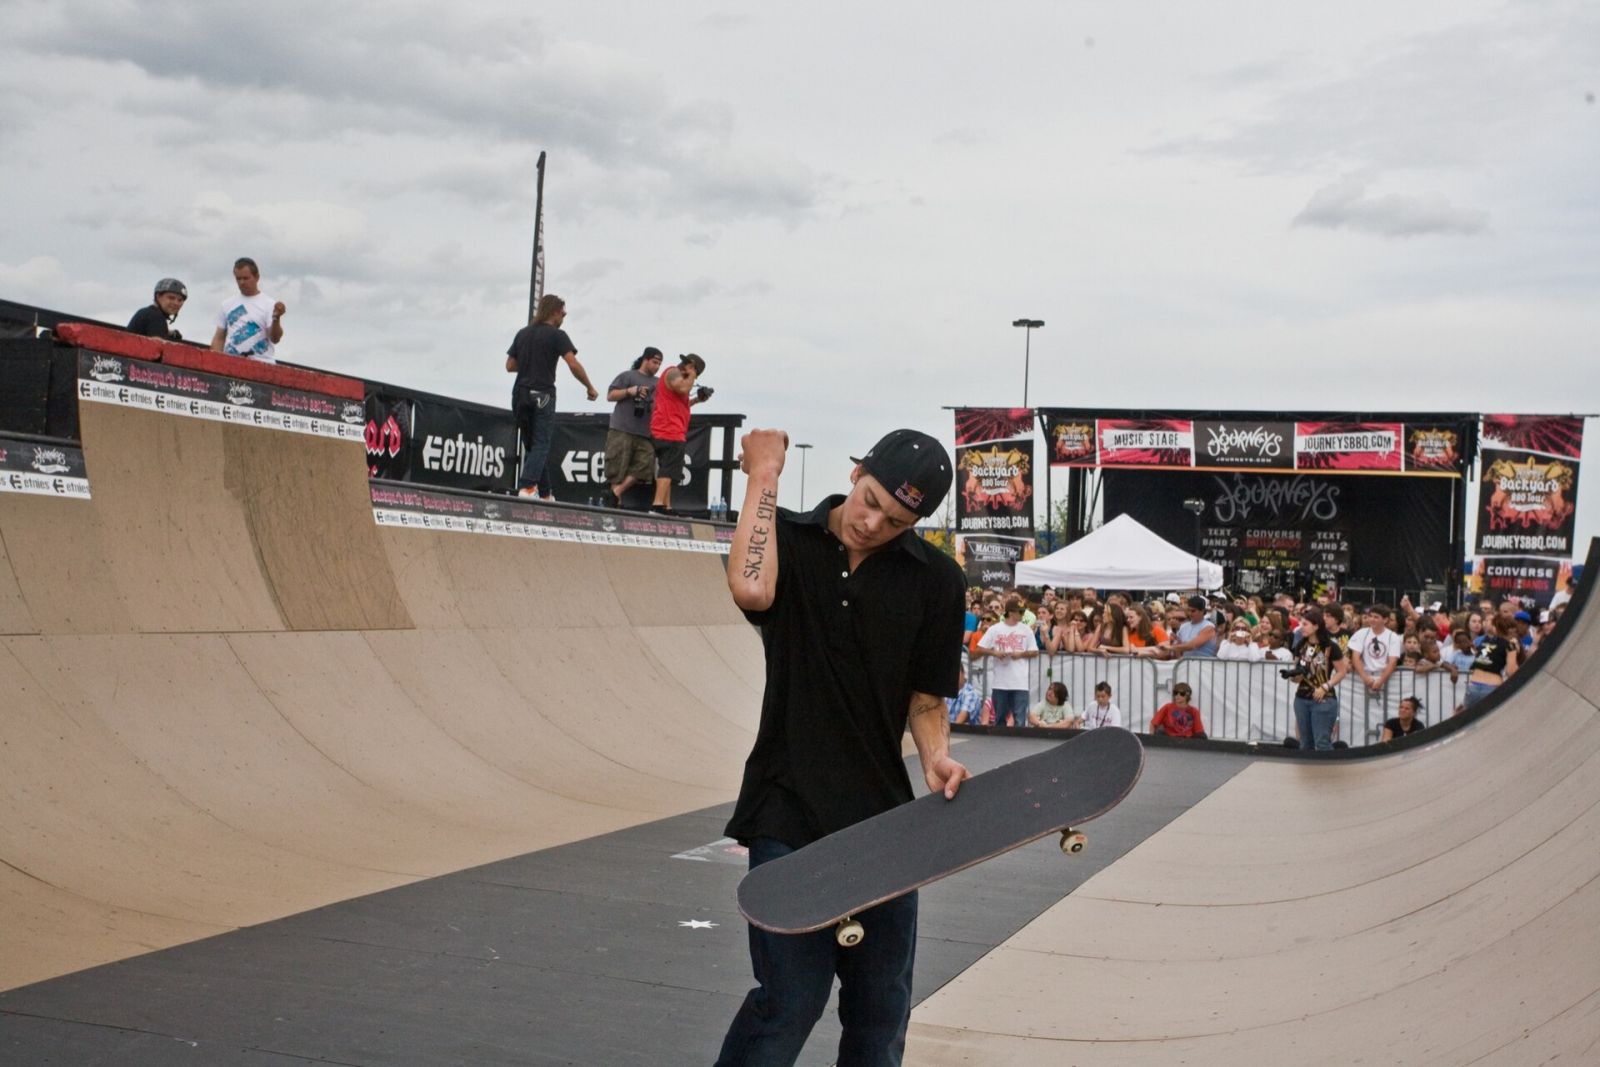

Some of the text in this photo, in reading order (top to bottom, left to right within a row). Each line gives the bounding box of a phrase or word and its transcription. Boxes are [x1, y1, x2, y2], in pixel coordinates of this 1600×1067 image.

[92, 385, 116, 399] etnies
[130, 391, 153, 405] etnies
[166, 397, 188, 411] etnies
[200, 403, 221, 416] etnies
[1114, 432, 1179, 446] MUSIC STAGE
[1207, 424, 1283, 457] JOURNEYS
[1303, 435, 1392, 450] JOURNEYSBBQ.COM
[441, 433, 506, 479] etnies
[972, 465, 1019, 479] Backyard
[24, 477, 50, 490] etnies
[1500, 477, 1559, 494] Backyard
[1214, 472, 1341, 522] JOURNEYS
[1527, 492, 1546, 502] Tour
[756, 488, 777, 521] LIFE
[961, 516, 1029, 530] JOURNEYSBBQ.COM
[1207, 528, 1232, 537] TEXT
[1246, 529, 1302, 541] CONVERSE
[1316, 531, 1342, 540] TEXT
[1202, 538, 1228, 547] BAND
[1229, 537, 1239, 547] 2
[1310, 542, 1338, 551] BAND
[1339, 541, 1349, 551] 2
[1481, 535, 1567, 551] JOURNEYSBBQ.COM
[1212, 549, 1225, 558] TO
[1321, 553, 1335, 561] TO
[1487, 566, 1554, 578] CONVERSE
